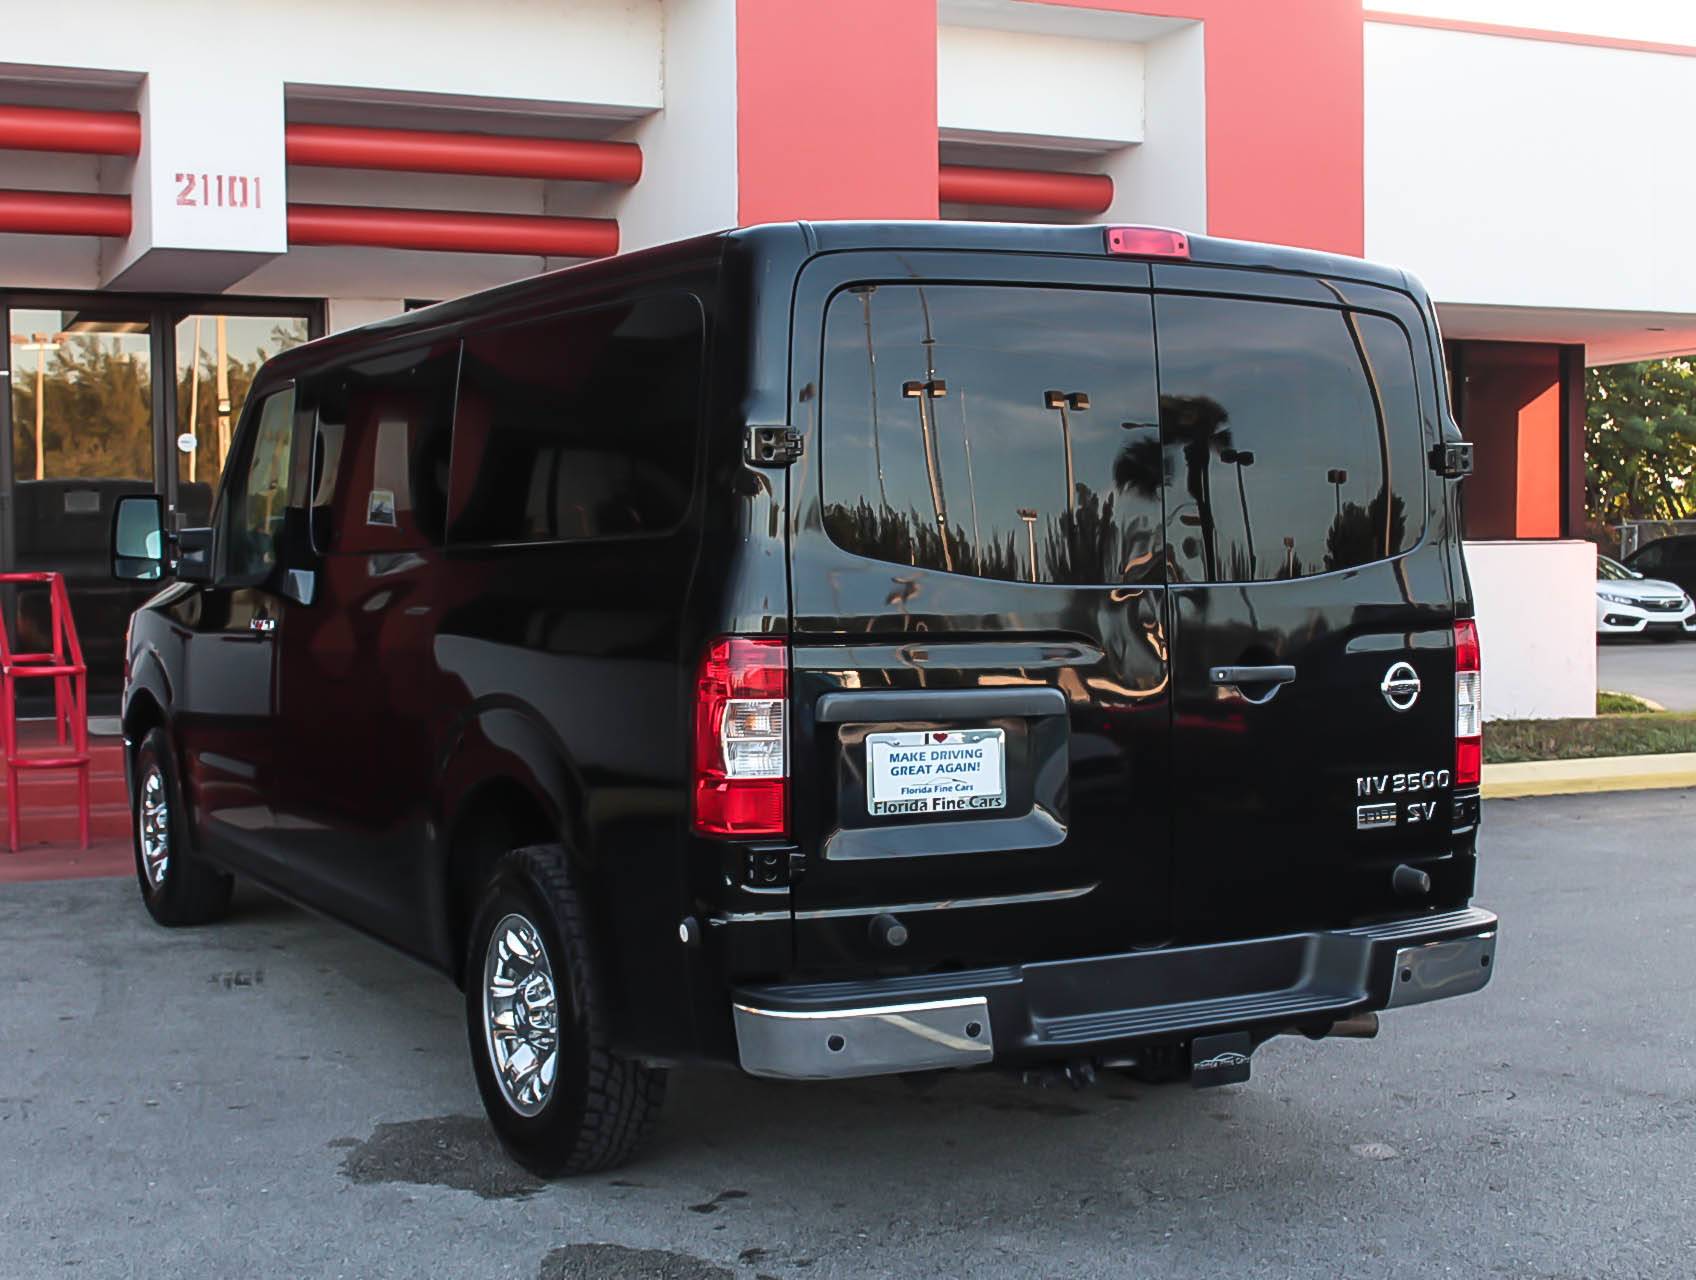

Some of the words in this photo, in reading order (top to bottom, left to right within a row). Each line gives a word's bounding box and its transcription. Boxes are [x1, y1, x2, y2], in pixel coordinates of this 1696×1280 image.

[175, 173, 261, 208] 21101
[889, 751, 926, 763] MAKE
[930, 748, 983, 761] DRIVING
[890, 764, 932, 776] GREAT
[936, 762, 981, 774] AGAIN!
[901, 786, 932, 795] Florida
[934, 784, 953, 793] Fine
[955, 783, 974, 792] Cars
[873, 800, 928, 814] Florida
[932, 797, 965, 811] Fine
[968, 795, 1002, 809] Cars
[1407, 801, 1437, 823] SV
